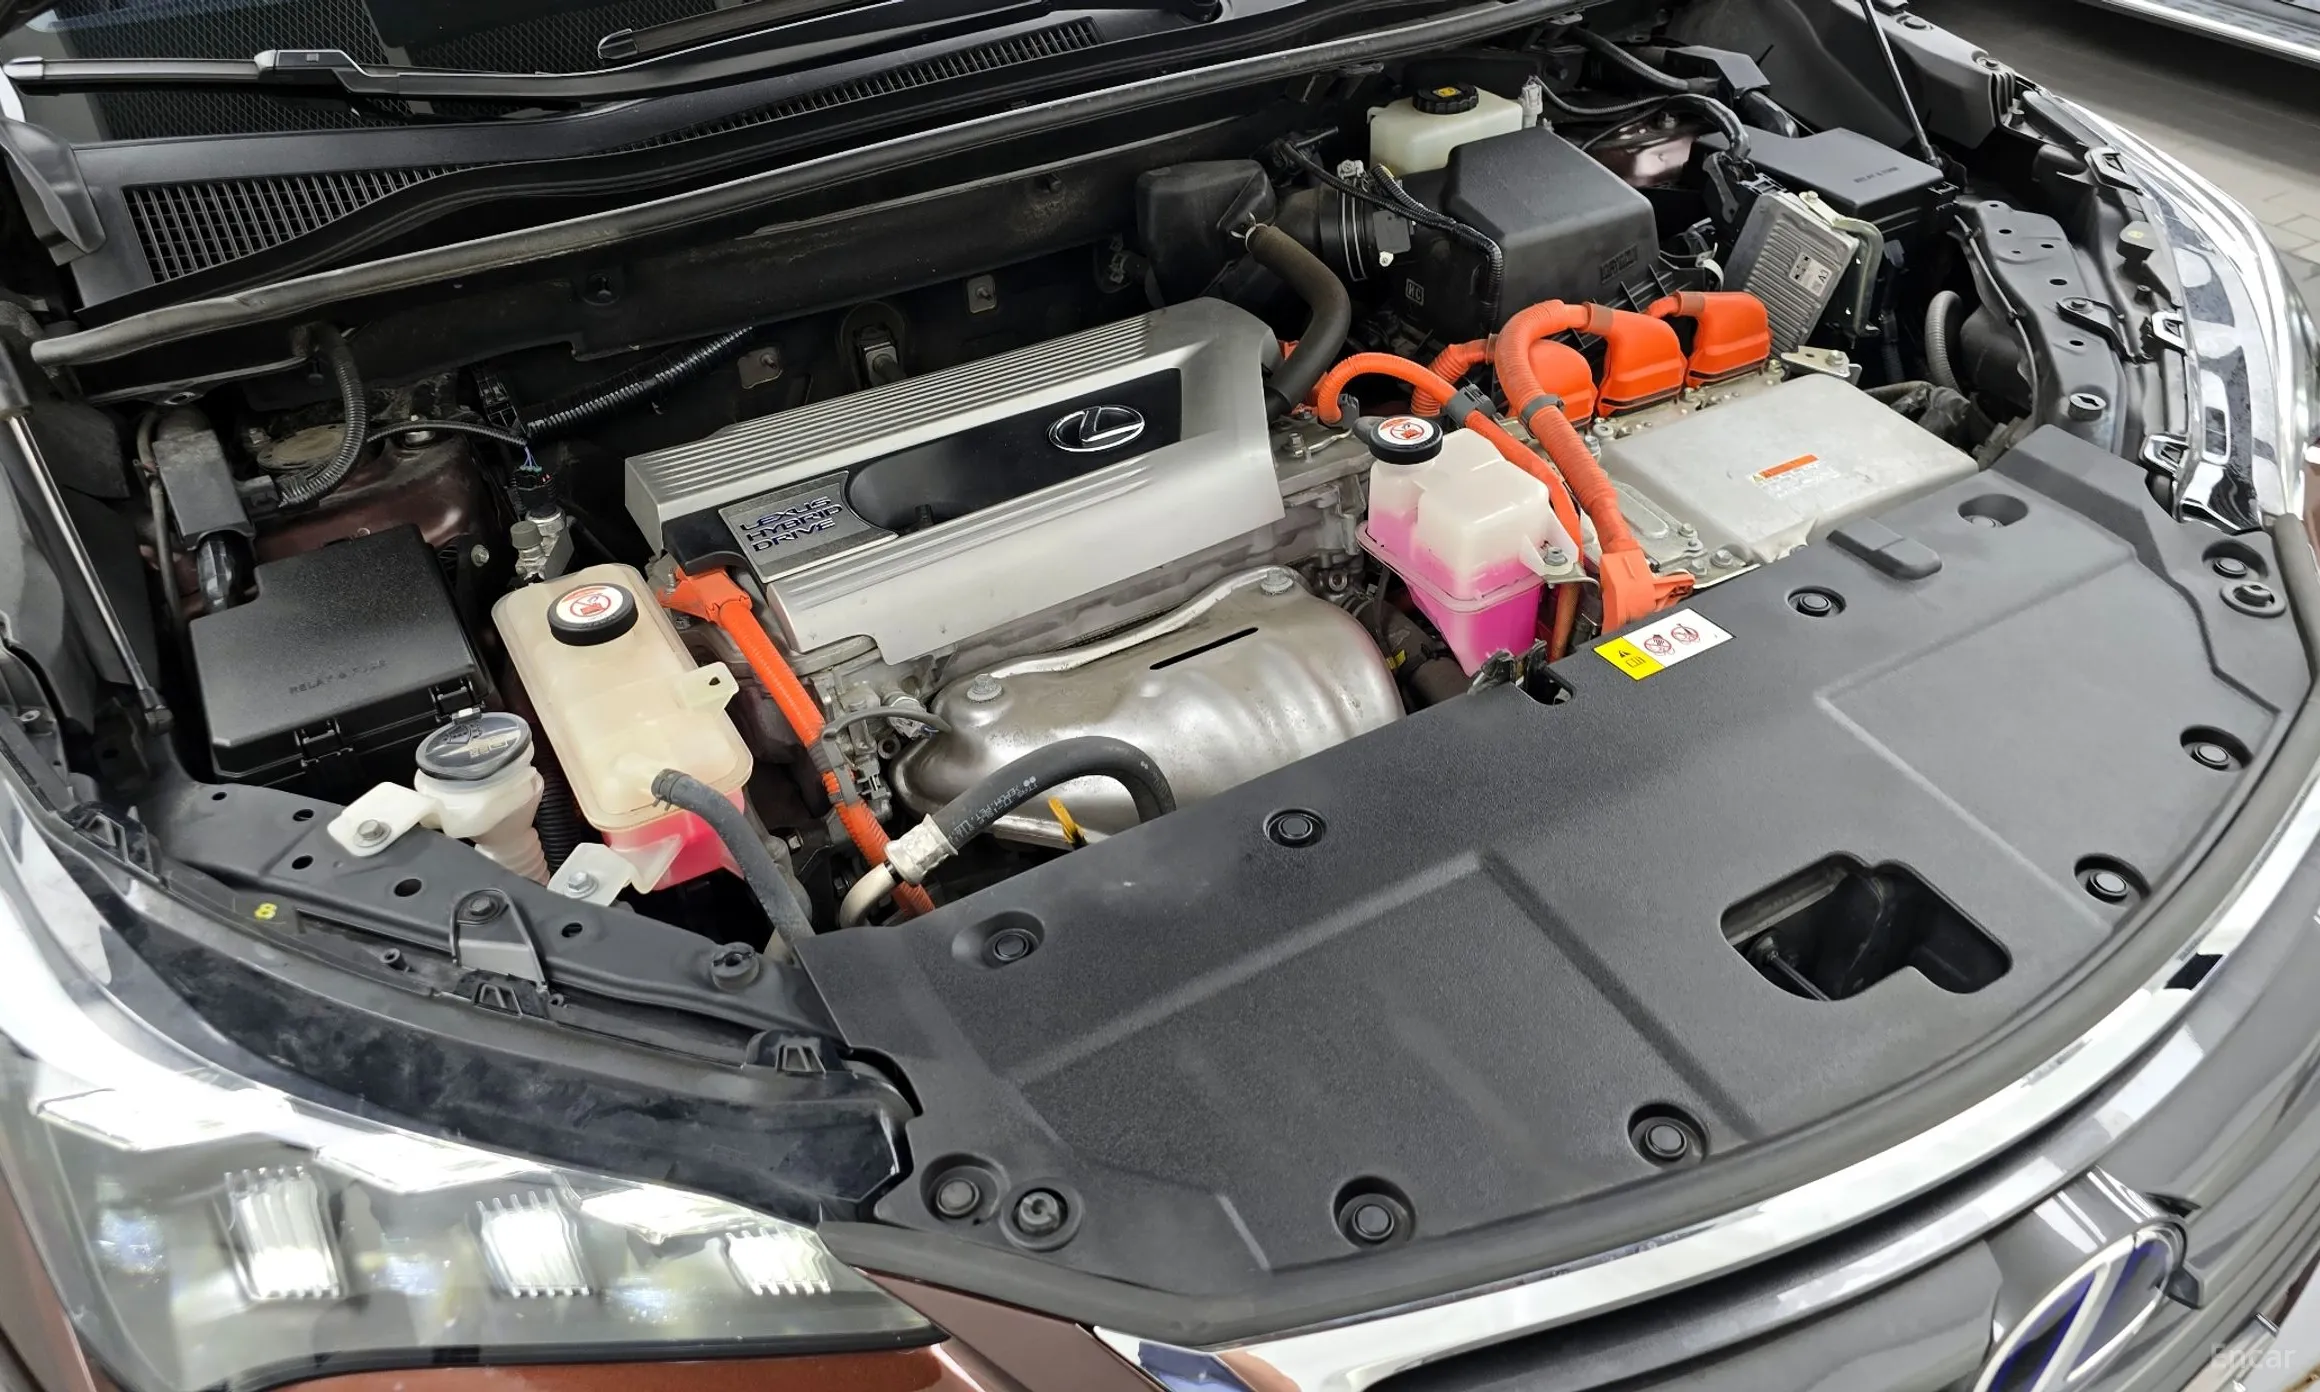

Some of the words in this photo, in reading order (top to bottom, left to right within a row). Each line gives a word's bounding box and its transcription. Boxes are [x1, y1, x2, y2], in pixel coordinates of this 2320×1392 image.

[740, 496, 832, 531] LEXUS
[746, 504, 843, 542] HYBRID
[751, 517, 836, 552] DRIVE
